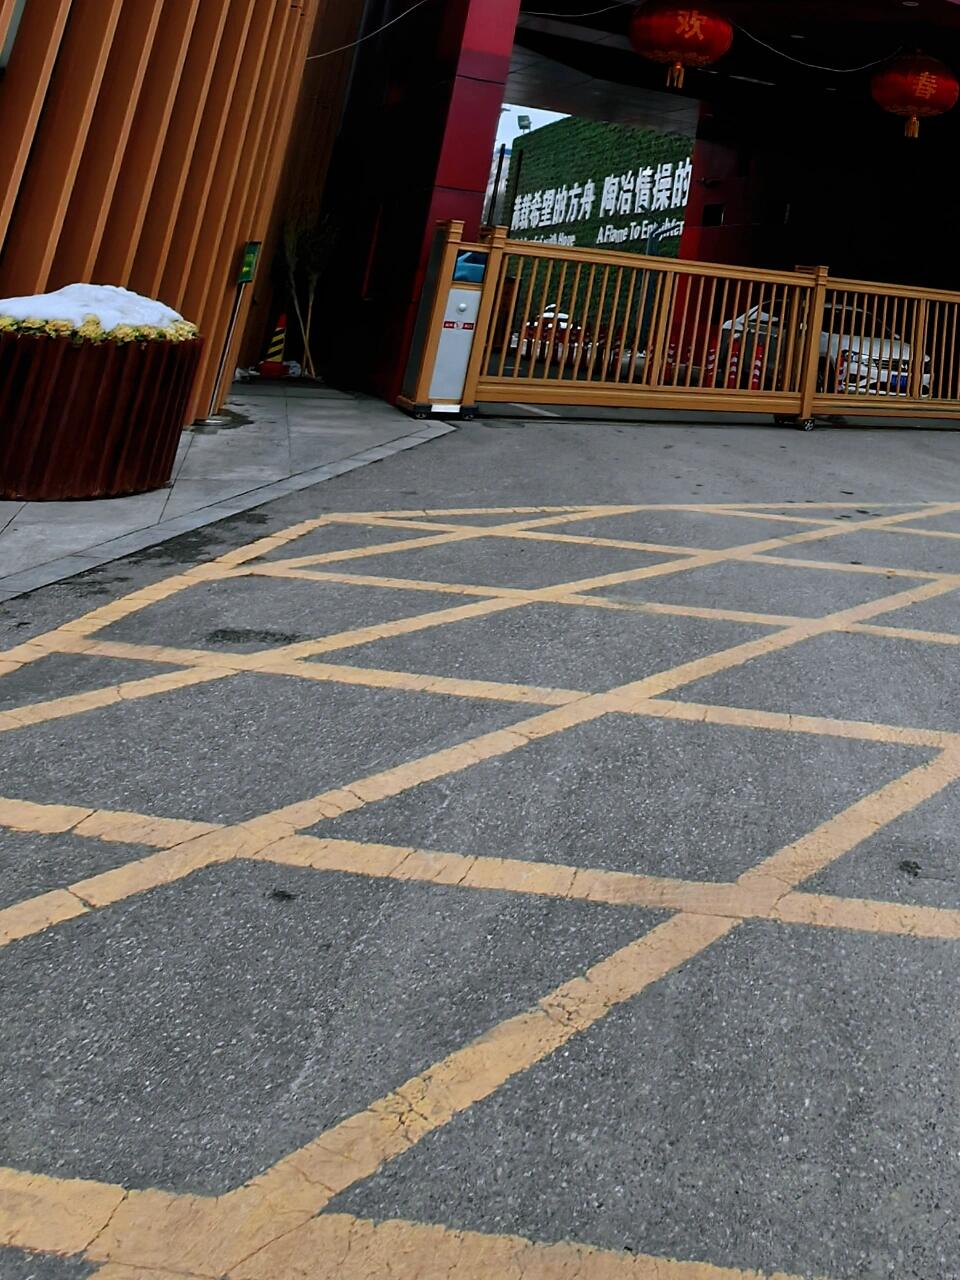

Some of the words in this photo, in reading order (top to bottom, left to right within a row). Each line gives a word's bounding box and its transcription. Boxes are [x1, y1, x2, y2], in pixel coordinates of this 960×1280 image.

[675, 10, 708, 40] 欢
[599, 156, 693, 218] 陶冶情操的
[596, 226, 605, 244] A
[630, 221, 641, 240] To
